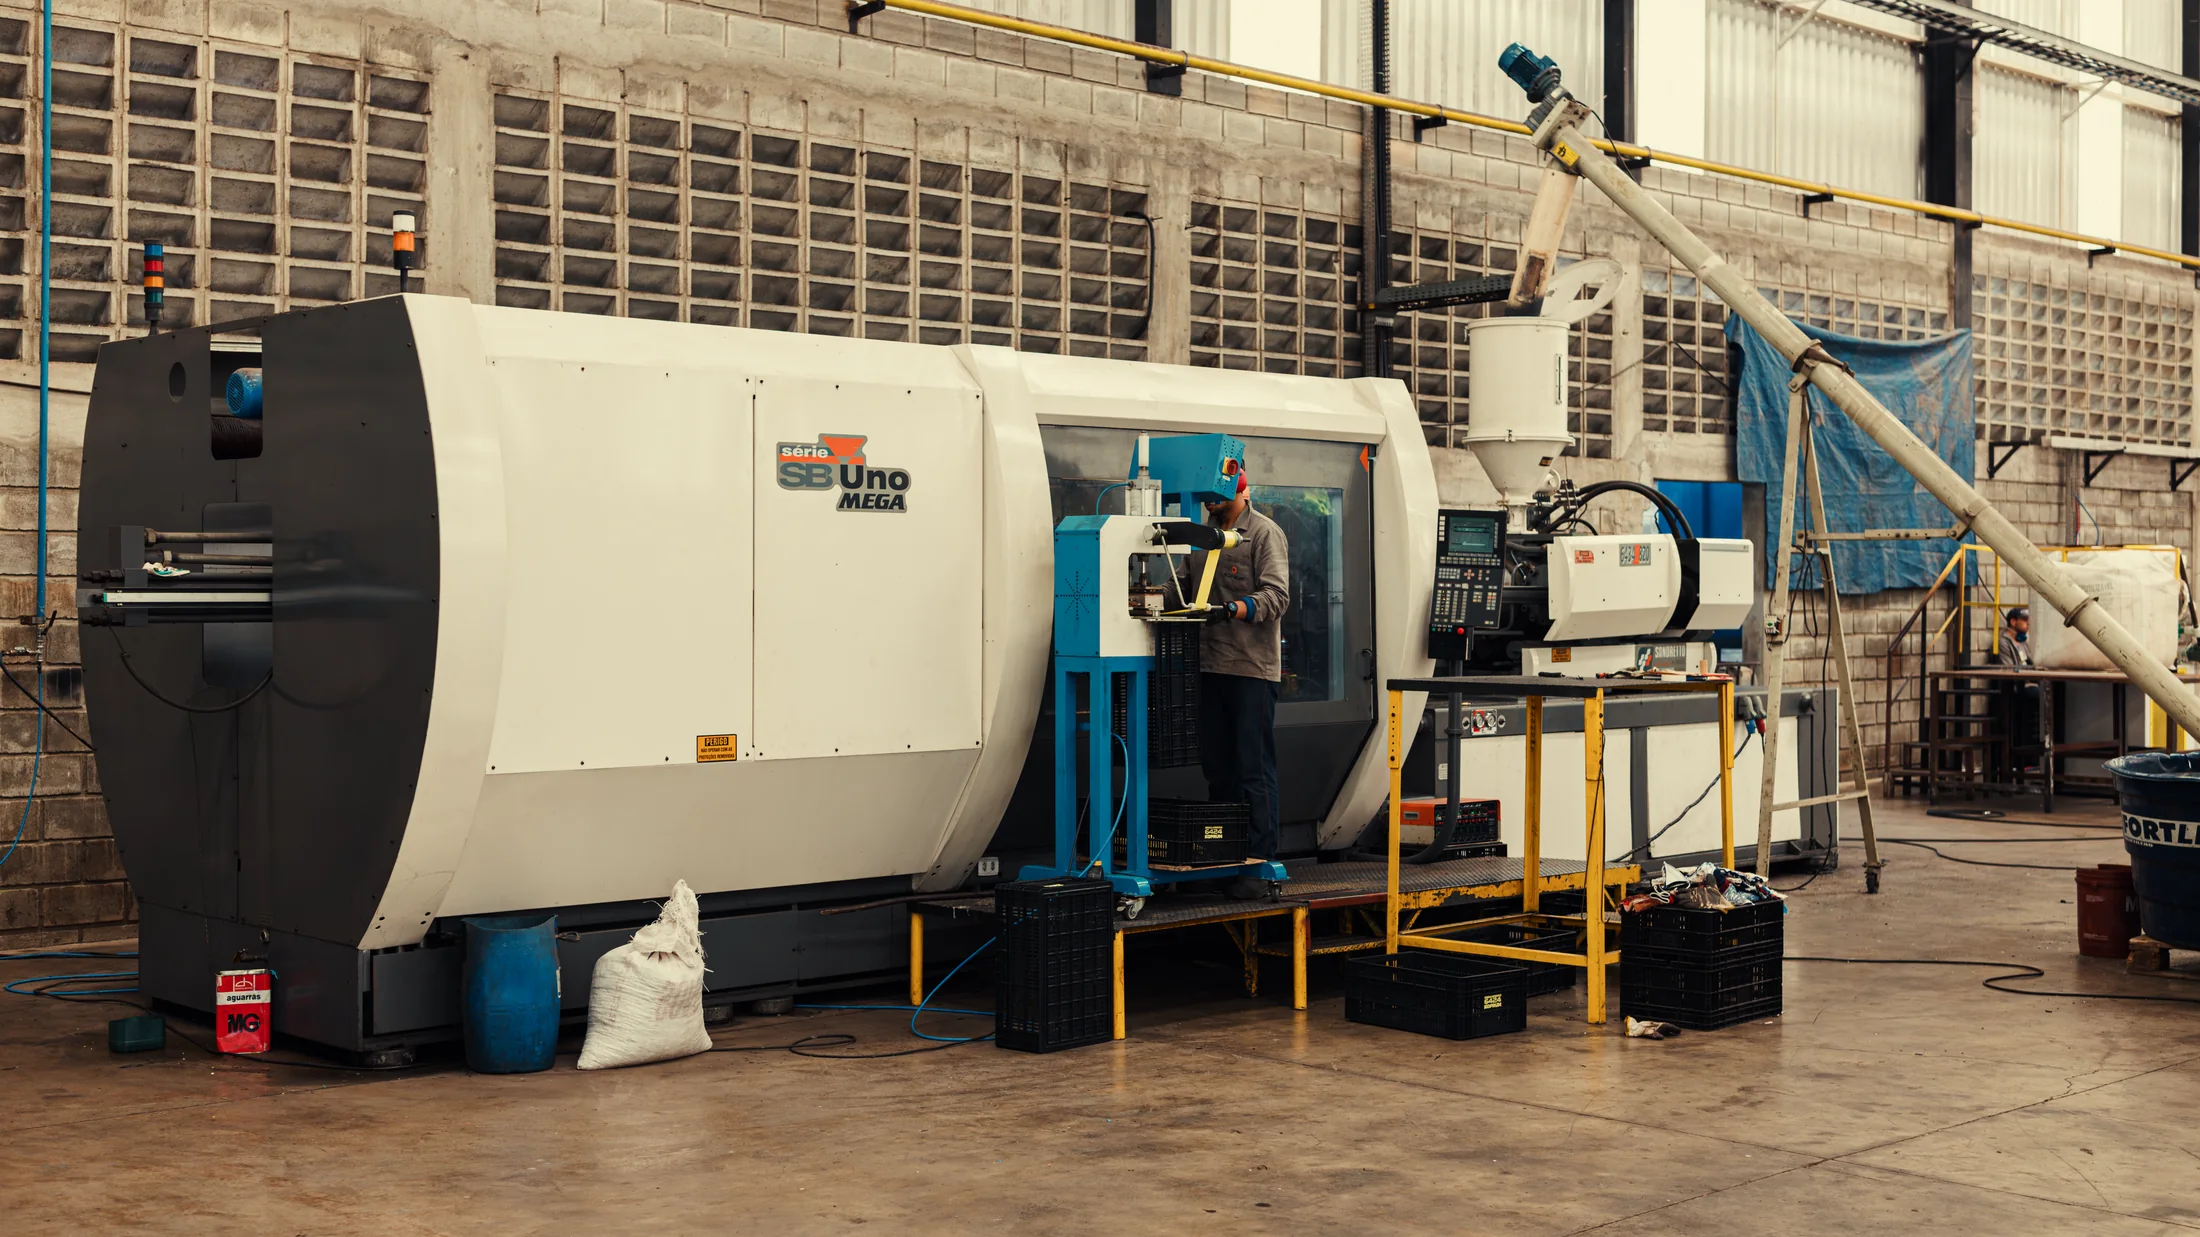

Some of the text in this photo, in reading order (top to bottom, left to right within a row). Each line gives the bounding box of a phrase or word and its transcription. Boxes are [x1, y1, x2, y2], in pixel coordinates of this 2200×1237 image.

[781, 445, 829, 459] série
[779, 462, 909, 491] SB Uno
[838, 492, 905, 510] MEGA
[705, 737, 728, 746] PERIGO
[1483, 996, 1502, 1005] 6424
[228, 1013, 260, 1034] MG
